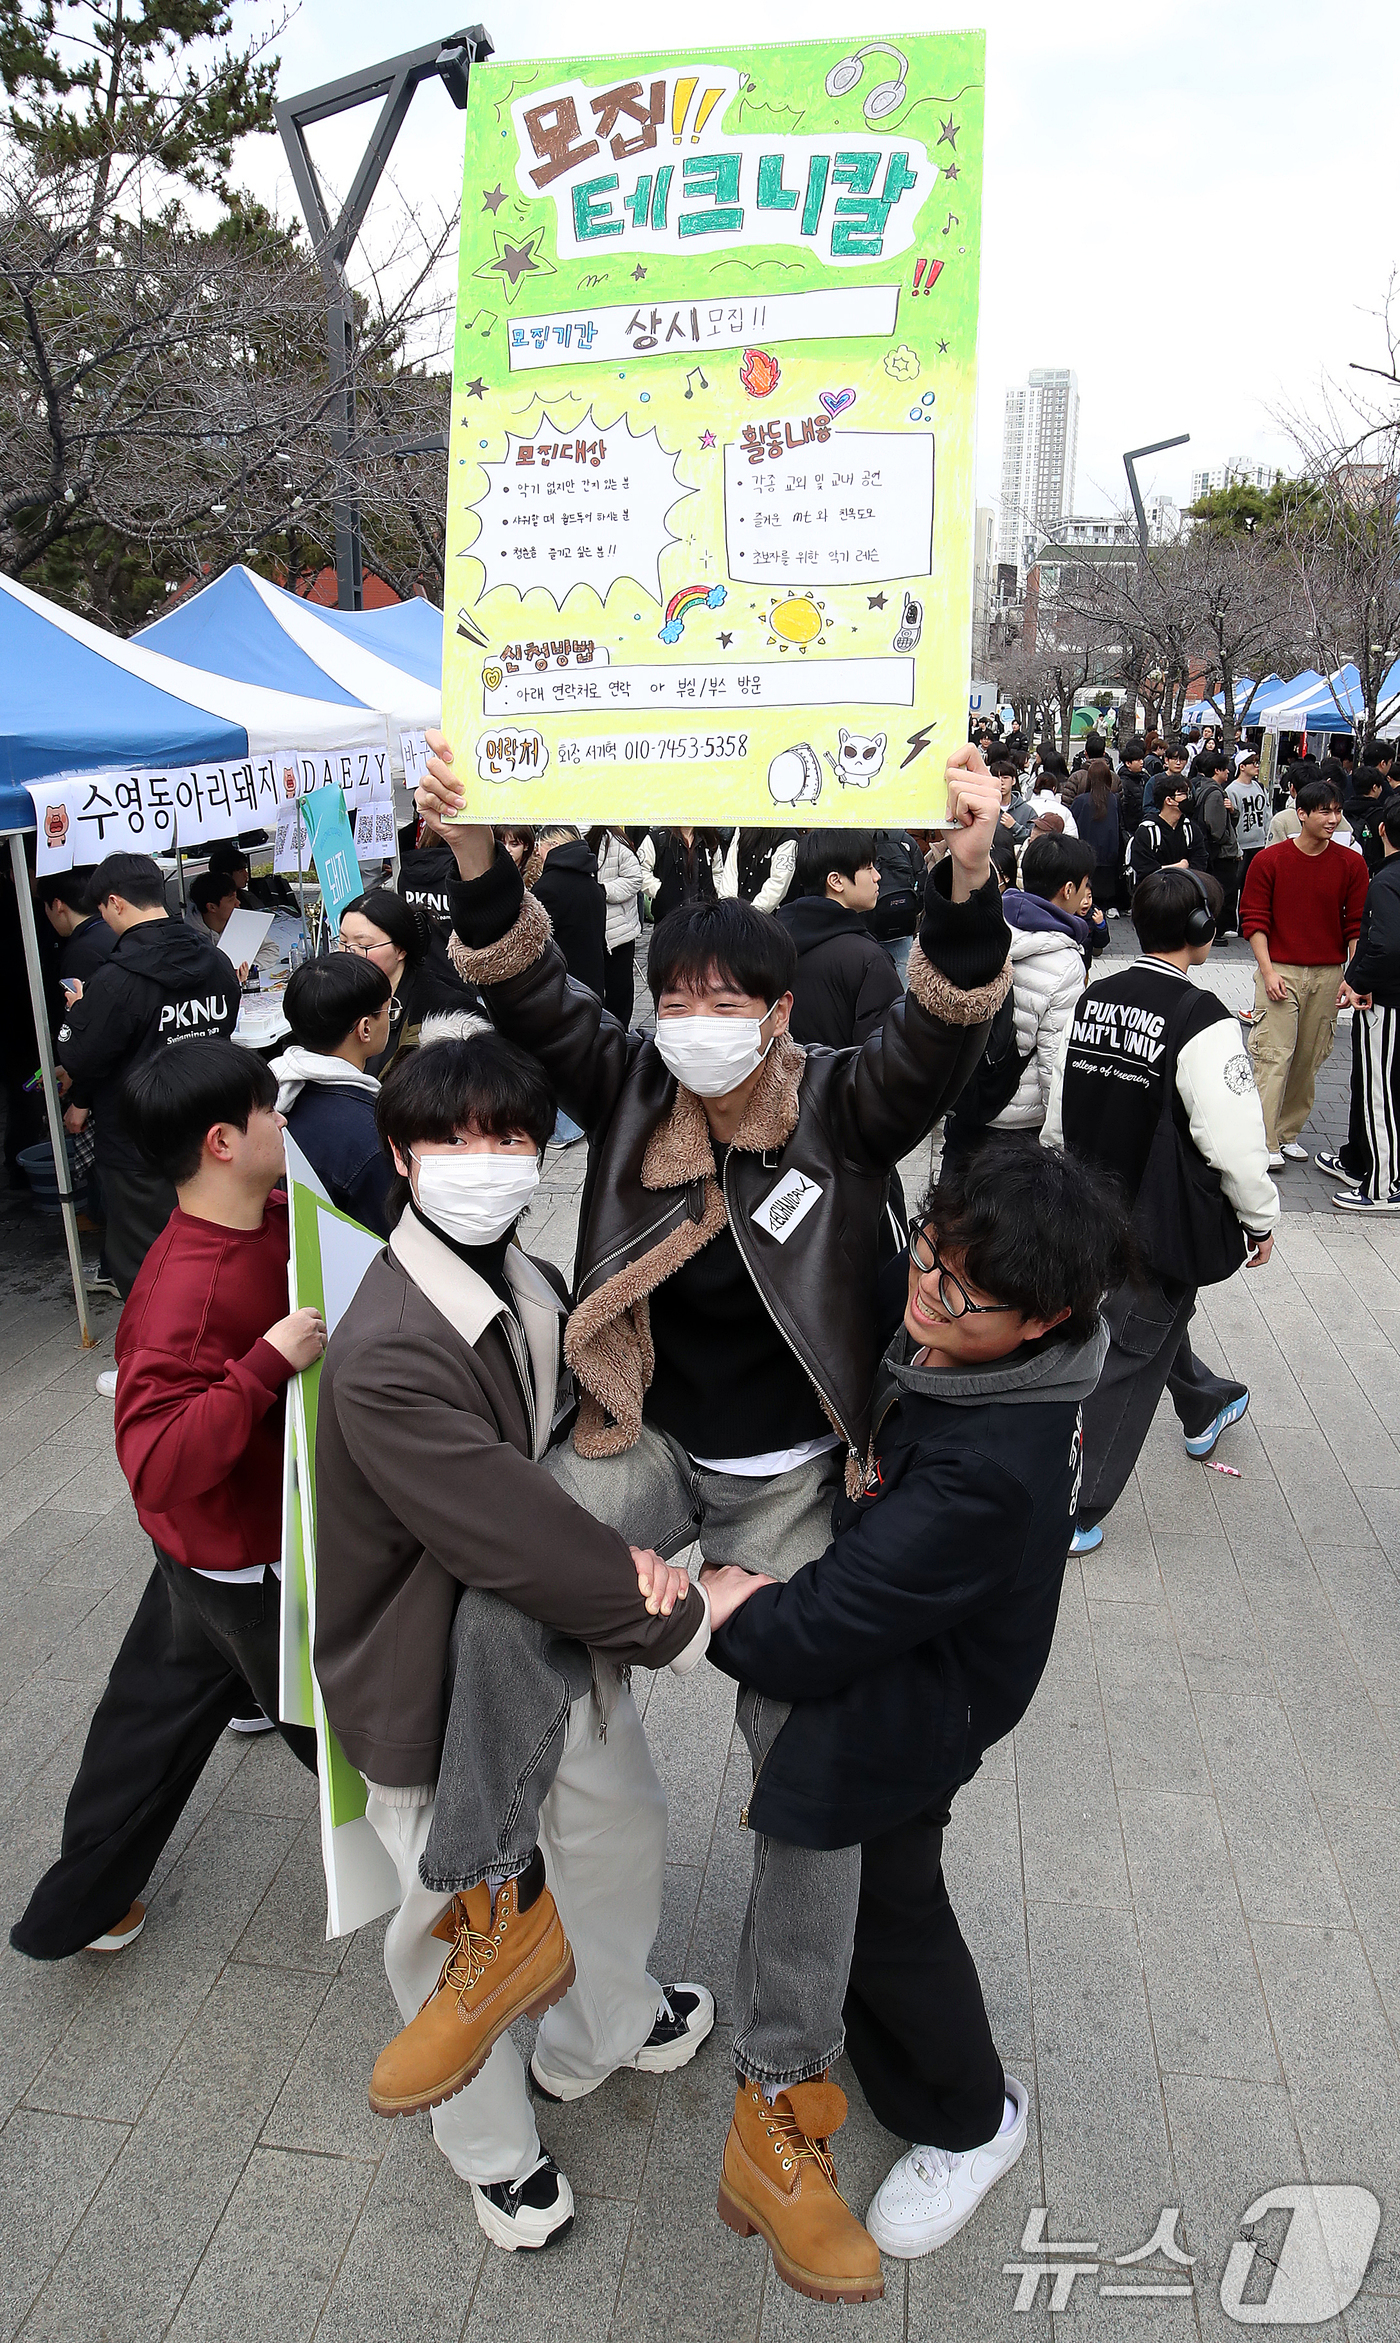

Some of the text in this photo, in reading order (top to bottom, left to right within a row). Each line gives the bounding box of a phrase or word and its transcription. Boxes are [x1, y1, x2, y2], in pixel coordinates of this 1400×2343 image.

[523, 77, 726, 190] 모집!!
[571, 152, 918, 257] 테크니칼
[511, 321, 598, 350] 모집기간
[625, 306, 700, 350] 상시
[515, 439, 607, 467] 모집대상
[740, 415, 831, 465] 활동내용
[517, 476, 630, 499] 악기 없지만 간지 있는 분
[751, 470, 883, 494] 각종 교외 및 교내 공연
[512, 513, 540, 528] 샤워할
[543, 512, 555, 525] 때
[596, 511, 619, 522] 하시는
[622, 508, 630, 522] 분
[753, 512, 782, 528] 즐거운
[816, 508, 829, 523] 와
[513, 545, 537, 560] 청춘을
[547, 547, 572, 561] 즐기고
[576, 545, 593, 559] 싶은
[752, 548, 880, 567] 초보자를 위한 악기 레슨
[500, 639, 595, 673] 신청방법
[516, 686, 545, 703] 아래
[551, 682, 602, 701] 연락처로
[608, 680, 632, 698] 연락
[649, 682, 666, 693] or
[737, 674, 762, 695] 방문
[486, 736, 540, 774] 연락처
[558, 743, 581, 765] 회장
[624, 734, 748, 760] 010-7453-5358
[77, 753, 386, 840] 수영동아리돼지 DAEZY
[158, 994, 228, 1032] PKNU
[1083, 999, 1166, 1039] PUKYONG
[1072, 1020, 1166, 1064] NAT'L UNIV
[1099, 1064, 1114, 1077] of
